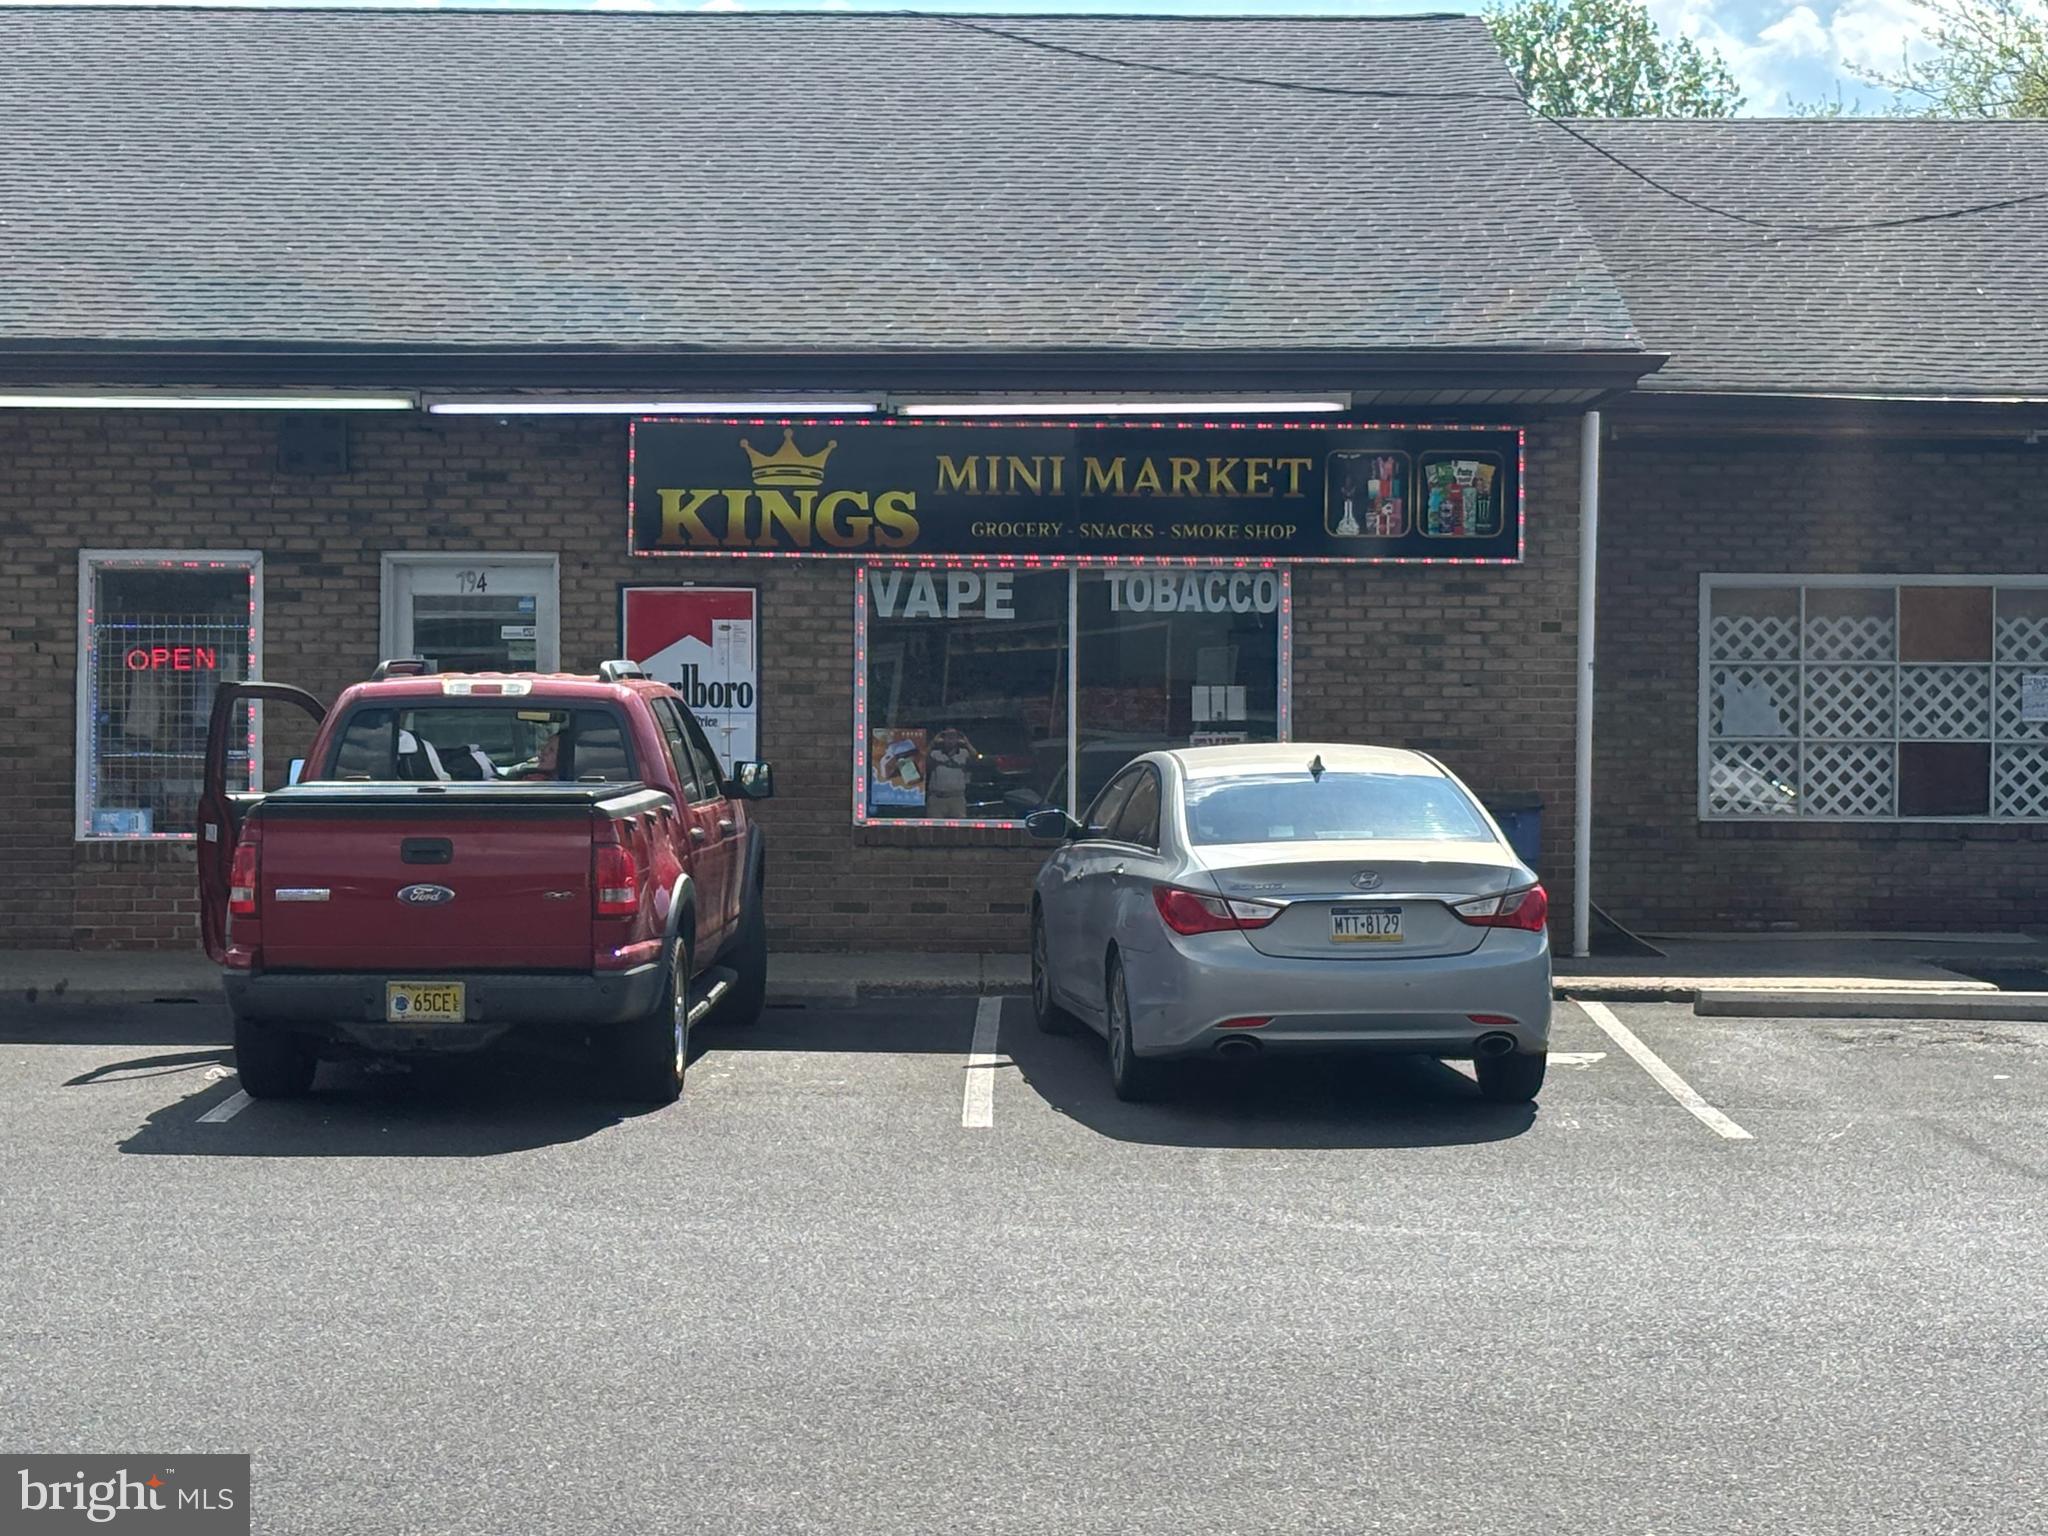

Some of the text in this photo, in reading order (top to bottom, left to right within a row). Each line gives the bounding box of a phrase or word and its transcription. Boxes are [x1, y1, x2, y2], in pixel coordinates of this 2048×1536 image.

[933, 455, 1313, 499] MINI MARKET
[655, 487, 921, 548] KINGS
[970, 521, 1064, 538] GROCERY
[1078, 522, 1155, 539] SNACKS
[1169, 523, 1240, 540] SMOKE
[1243, 523, 1298, 540] SHOP
[455, 570, 488, 594] 794
[1104, 571, 1279, 614] TOBACCO
[869, 570, 1016, 620] VAPE
[126, 647, 217, 672] OPEN
[410, 887, 441, 902] Ford
[414, 992, 452, 1012] 65CE
